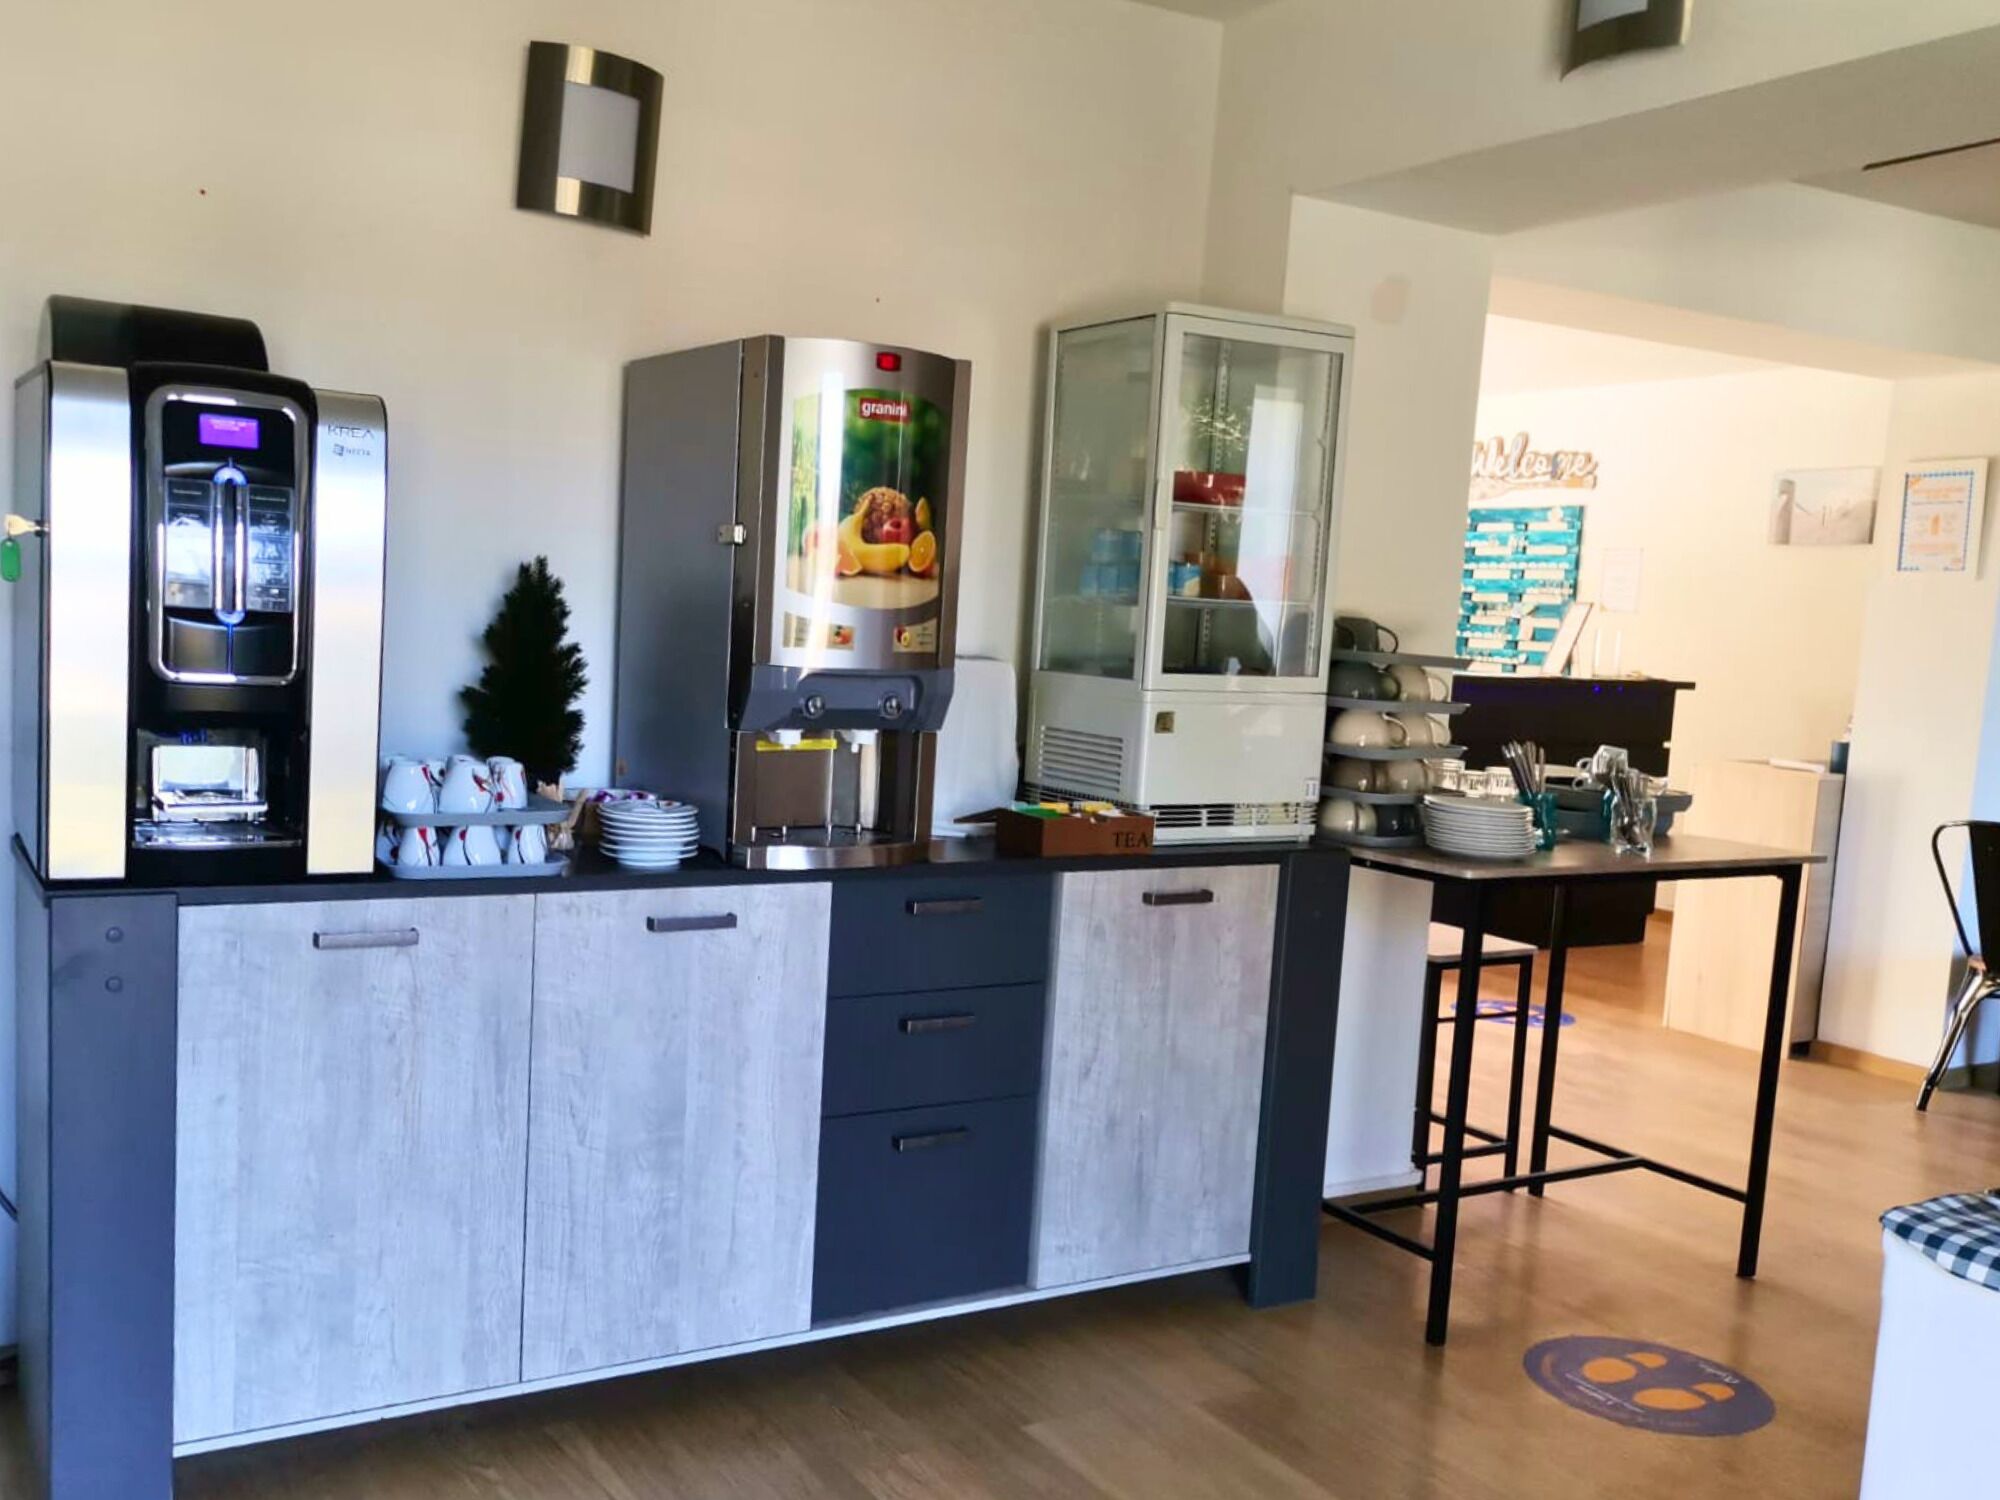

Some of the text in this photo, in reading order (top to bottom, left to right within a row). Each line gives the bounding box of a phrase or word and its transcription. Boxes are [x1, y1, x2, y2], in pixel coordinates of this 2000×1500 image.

[862, 401, 908, 417] granini
[328, 424, 375, 439] KREA
[1112, 832, 1149, 848] TEA
